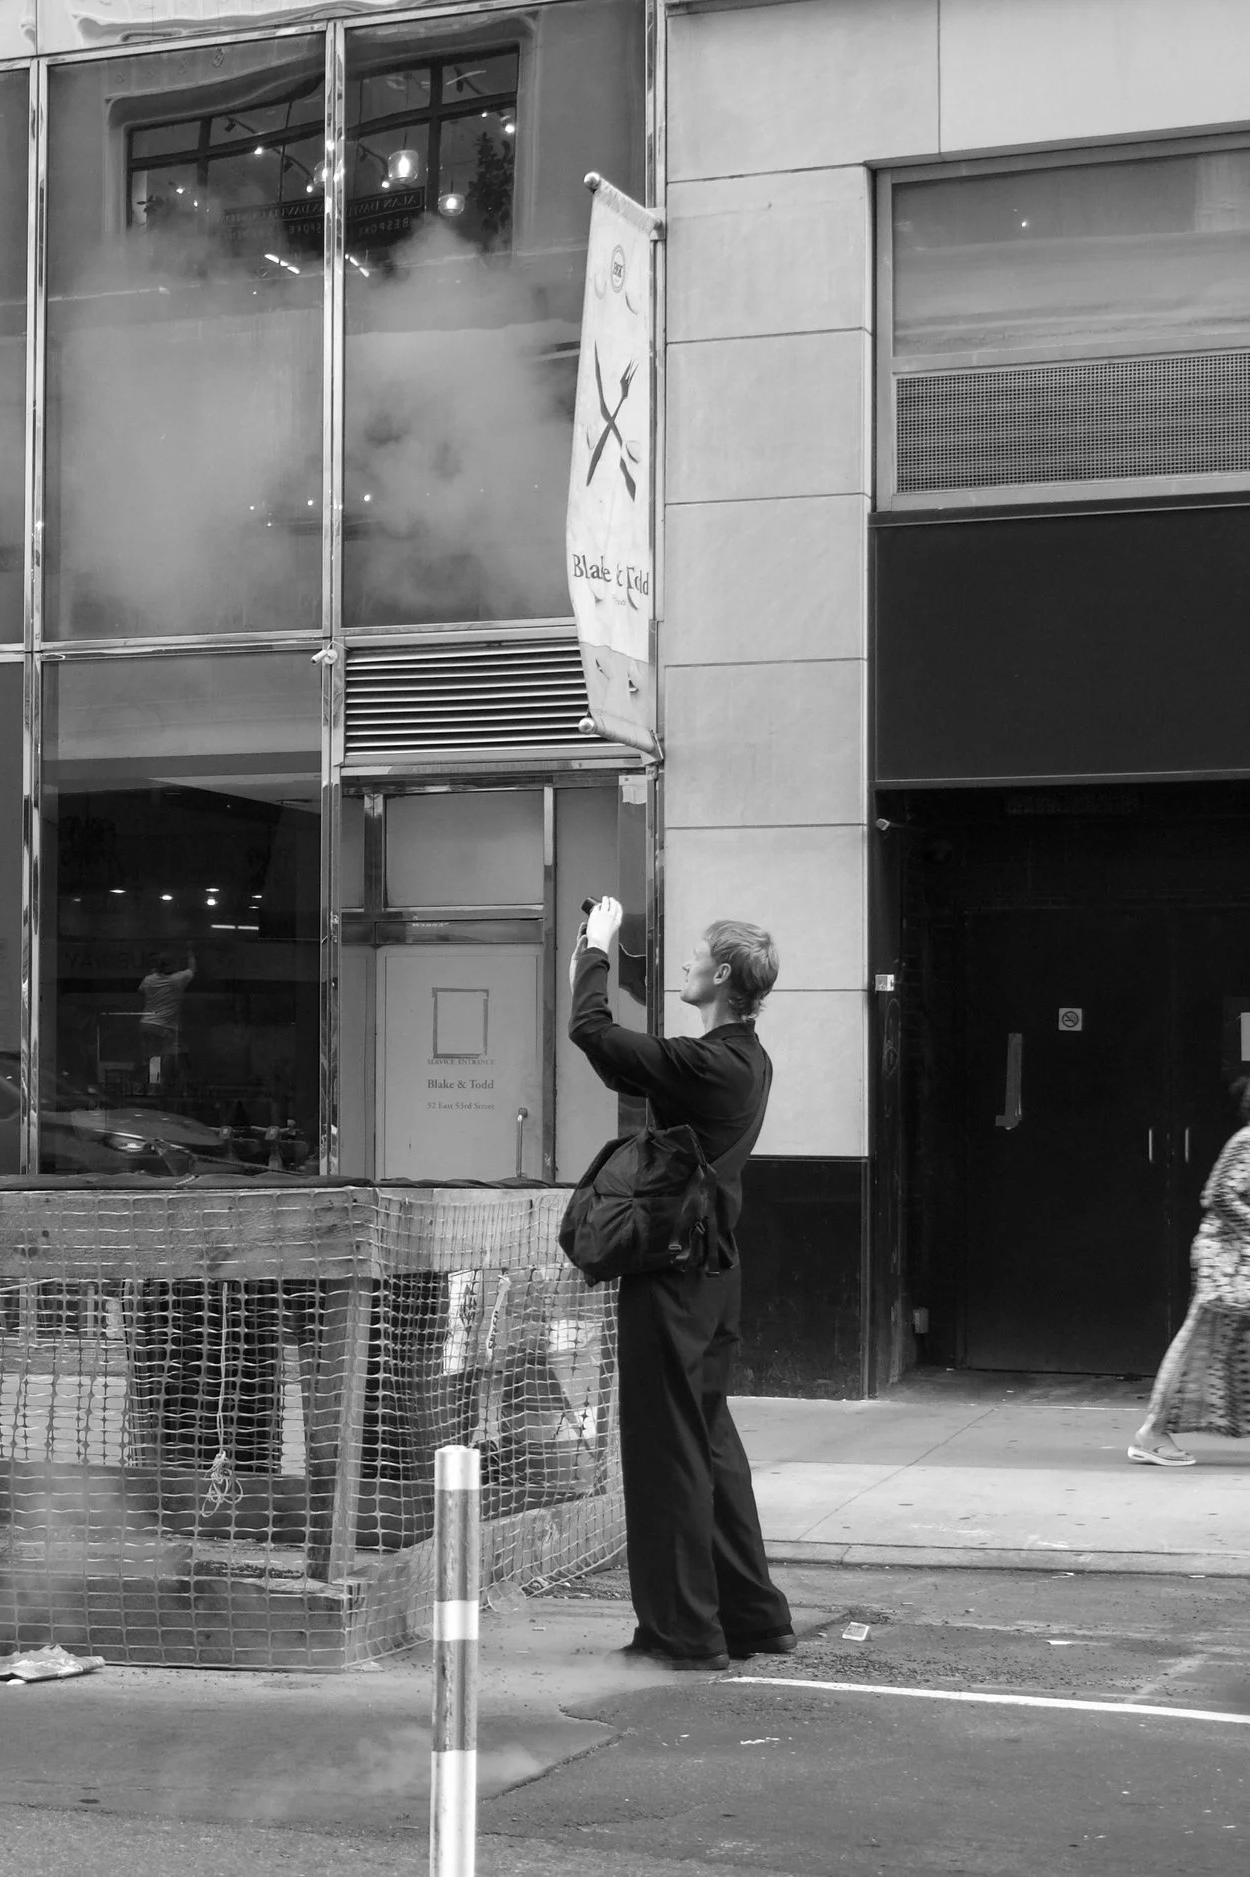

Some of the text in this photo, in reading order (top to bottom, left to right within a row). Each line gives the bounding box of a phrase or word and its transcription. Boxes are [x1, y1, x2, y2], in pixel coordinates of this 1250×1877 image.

[427, 1079, 494, 1089] Blake & Todd
[473, 1102, 495, 1110] Street
